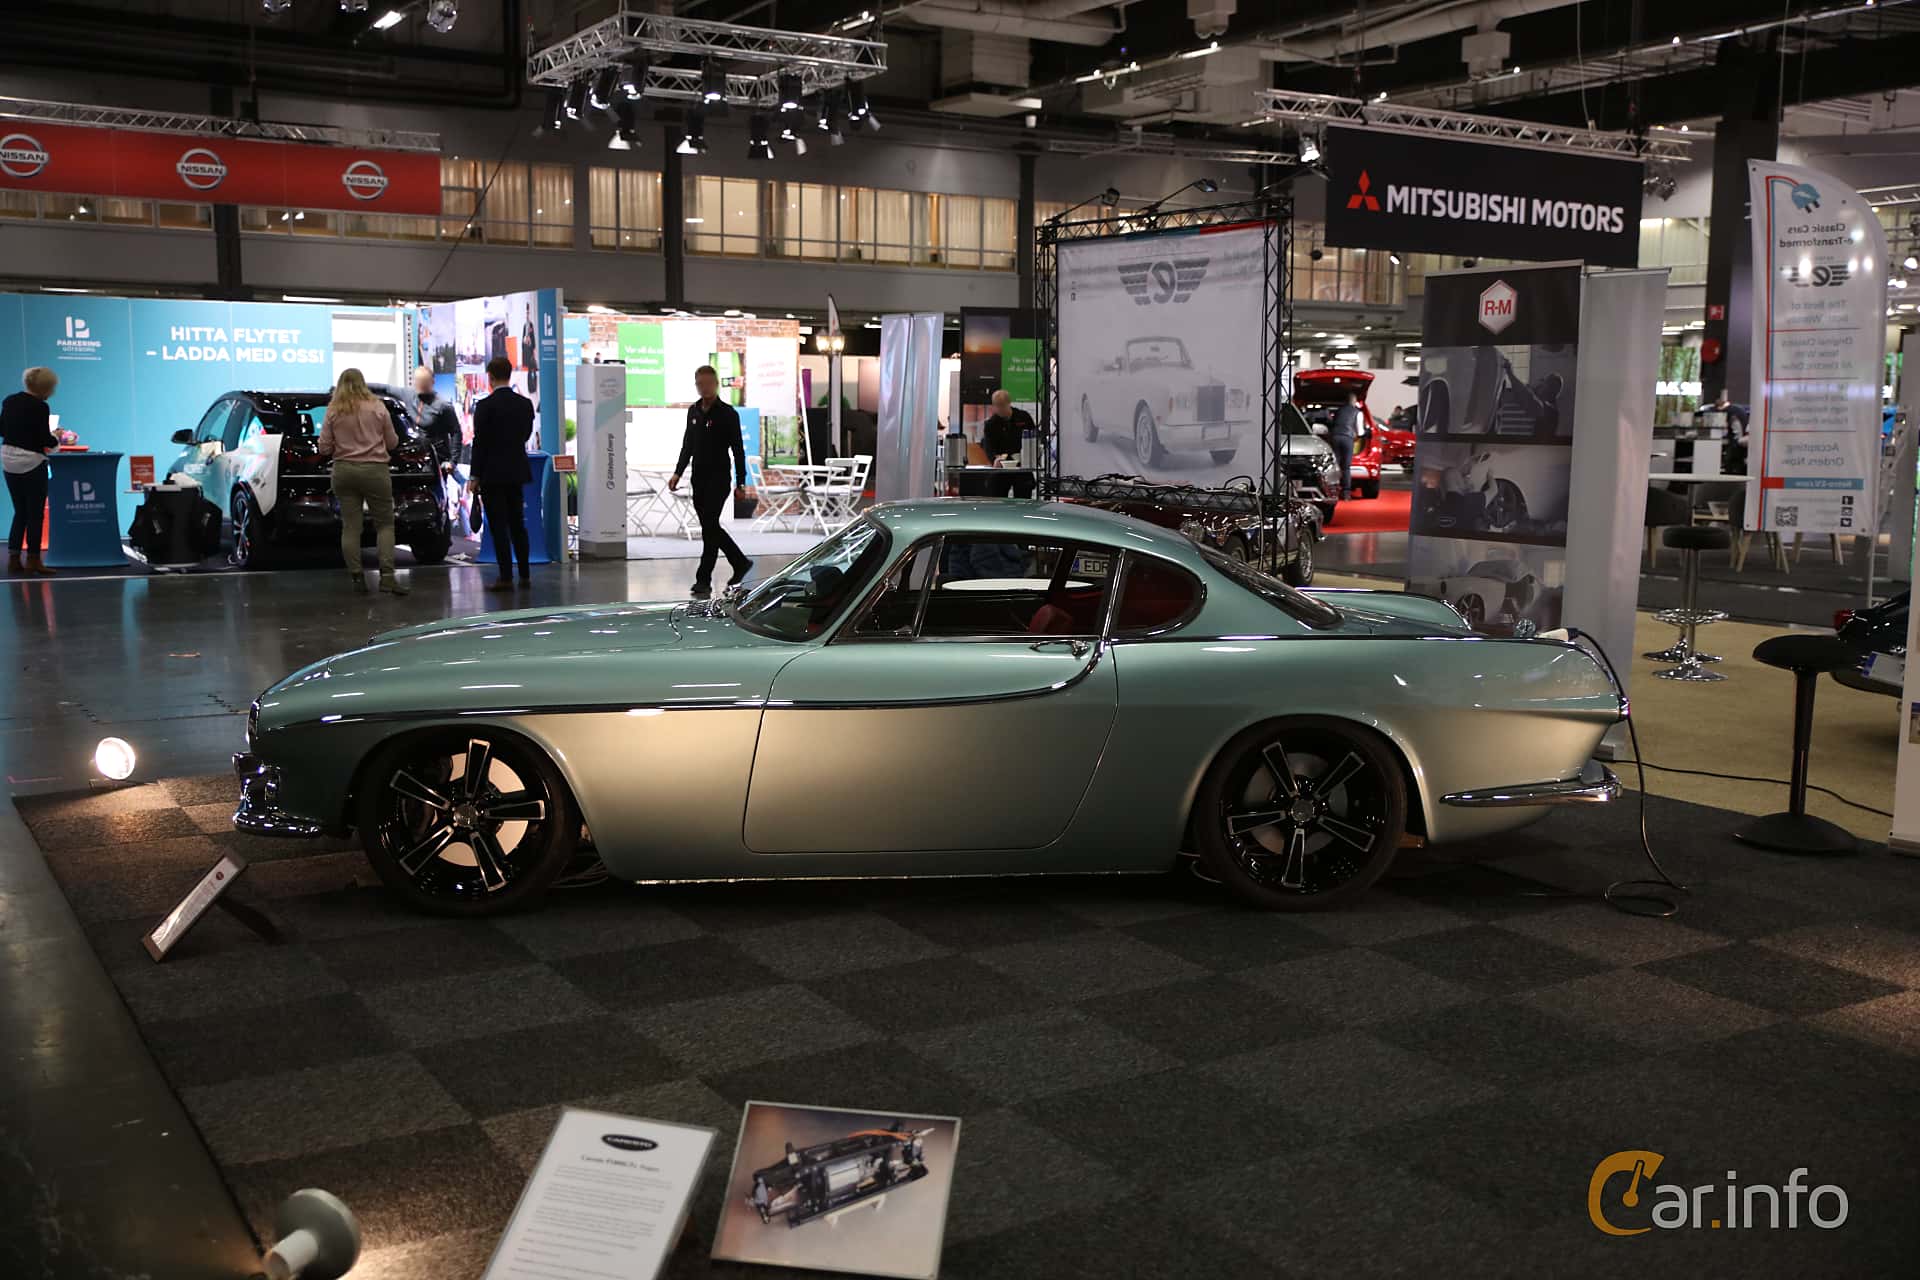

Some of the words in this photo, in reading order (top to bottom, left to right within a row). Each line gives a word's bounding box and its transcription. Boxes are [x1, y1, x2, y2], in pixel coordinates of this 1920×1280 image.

[0, 151, 45, 162] NISSAN
[180, 164, 224, 176] NISSAN
[345, 176, 386, 188] NISSAN
[1386, 184, 1526, 226] MITSUBISHI
[1531, 199, 1625, 234] MOTORS
[1483, 299, 1513, 316] R-M
[170, 325, 228, 342] HITTA
[233, 327, 302, 344] FLYTET
[56, 339, 103, 348] PARKERING
[162, 345, 231, 361] LADDA
[235, 346, 278, 362] MED
